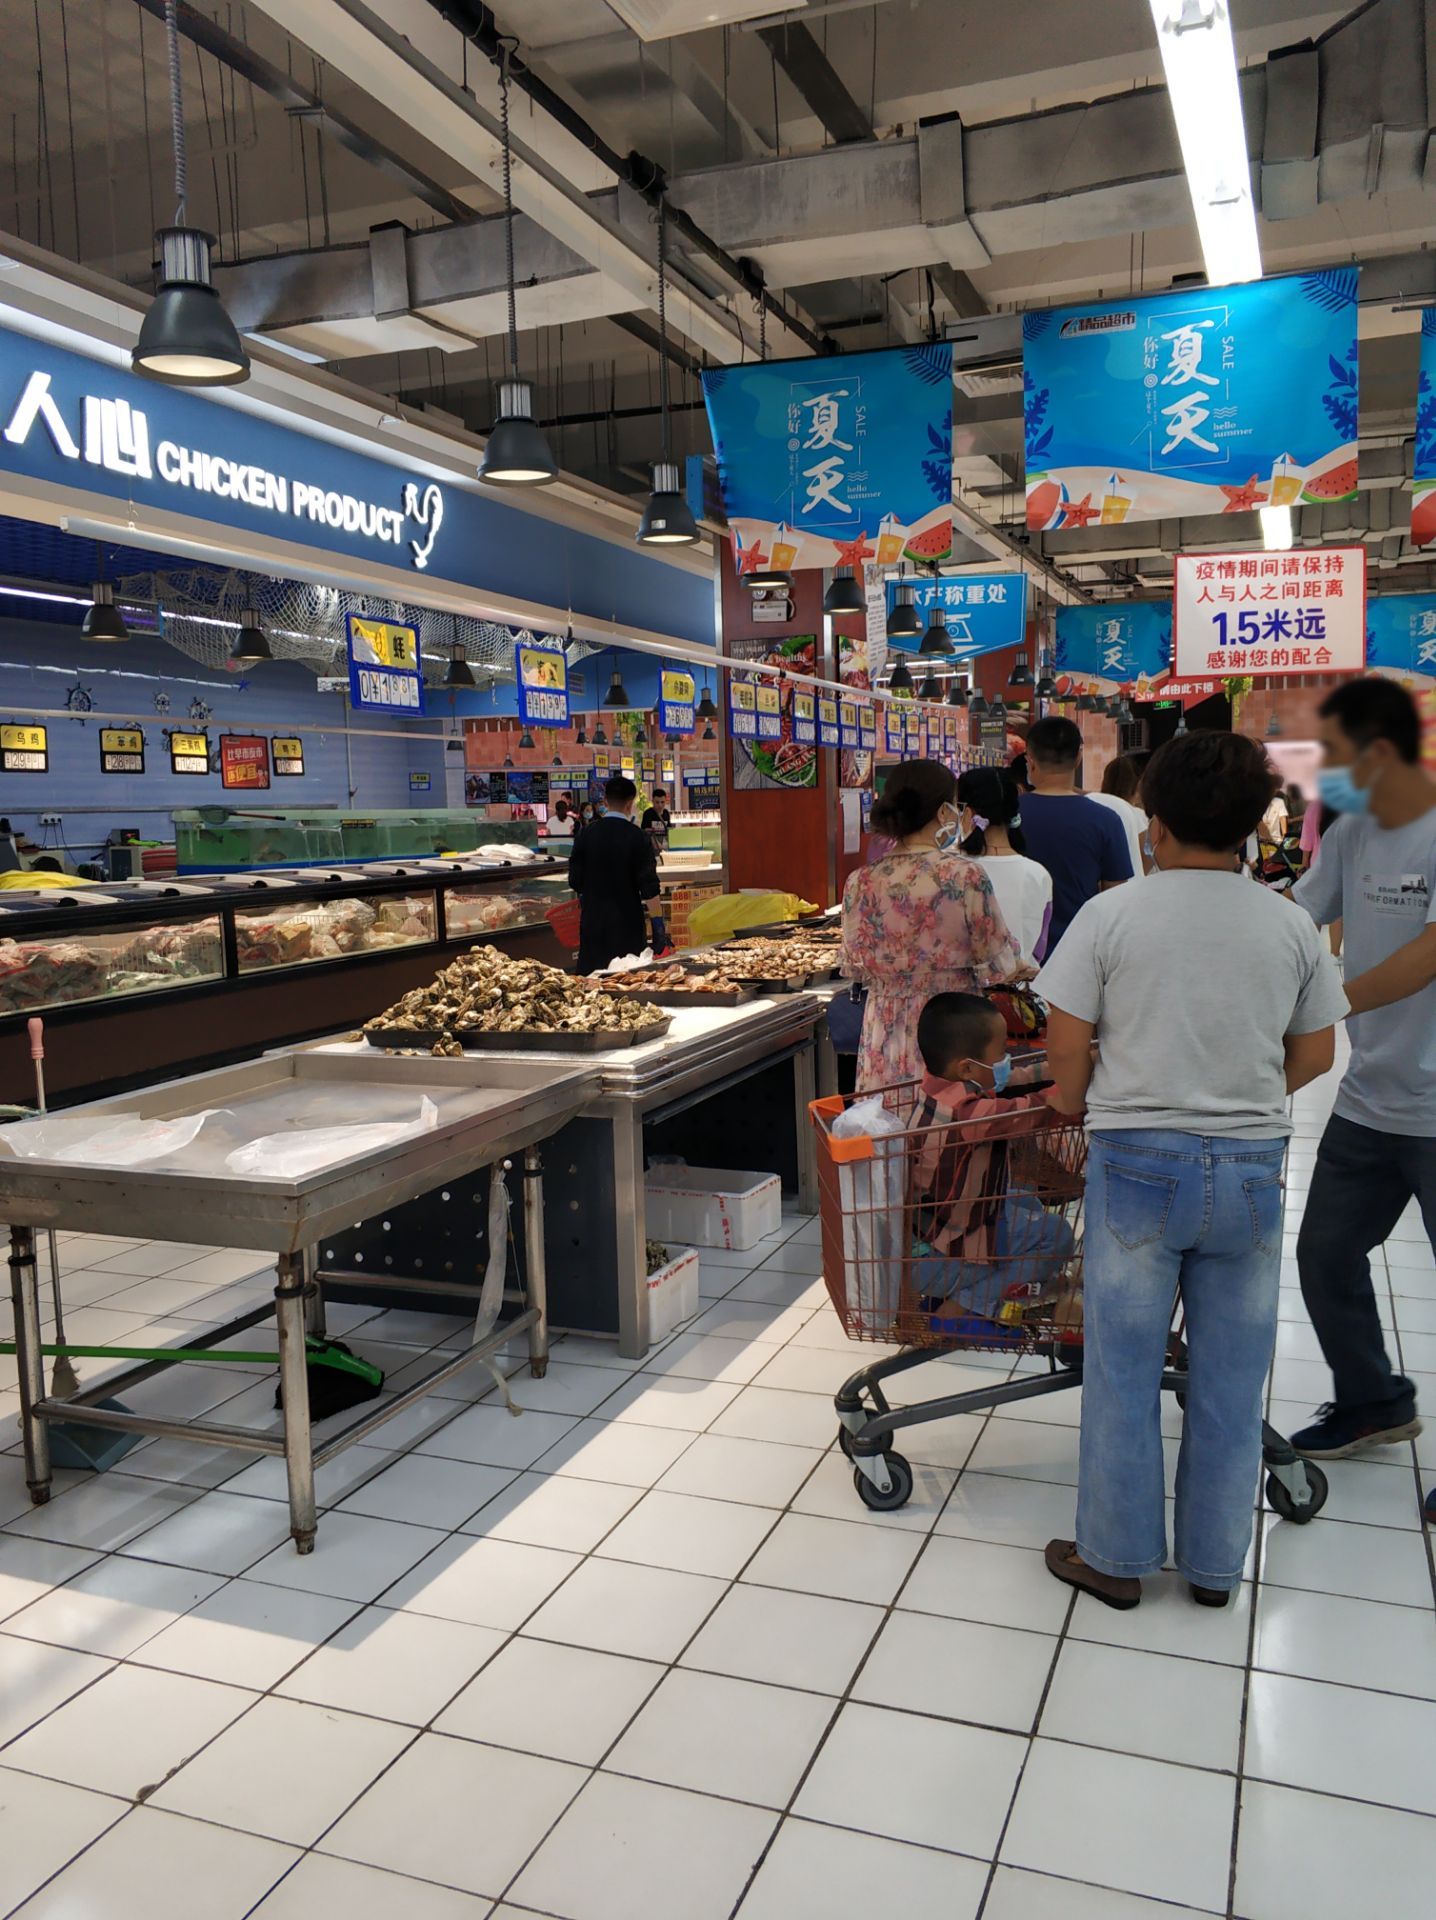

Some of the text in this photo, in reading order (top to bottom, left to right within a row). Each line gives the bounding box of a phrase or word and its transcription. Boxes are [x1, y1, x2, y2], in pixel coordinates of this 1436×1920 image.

[1143, 336, 1159, 370] 你好
[1221, 335, 1235, 370] SALE
[787, 403, 801, 434] 你好
[855, 405, 866, 437] SALE
[1213, 421, 1237, 431] hello
[1213, 429, 1253, 438] summer
[157, 441, 404, 544] CHICKEN PRODUCT
[847, 484, 867, 493] hello
[1196, 555, 1344, 580] 疫情期间请保持
[1196, 579, 1344, 604] 人与人之间距离
[1212, 607, 1326, 646] 1.5米远
[1207, 646, 1333, 669] 感谢您的配合
